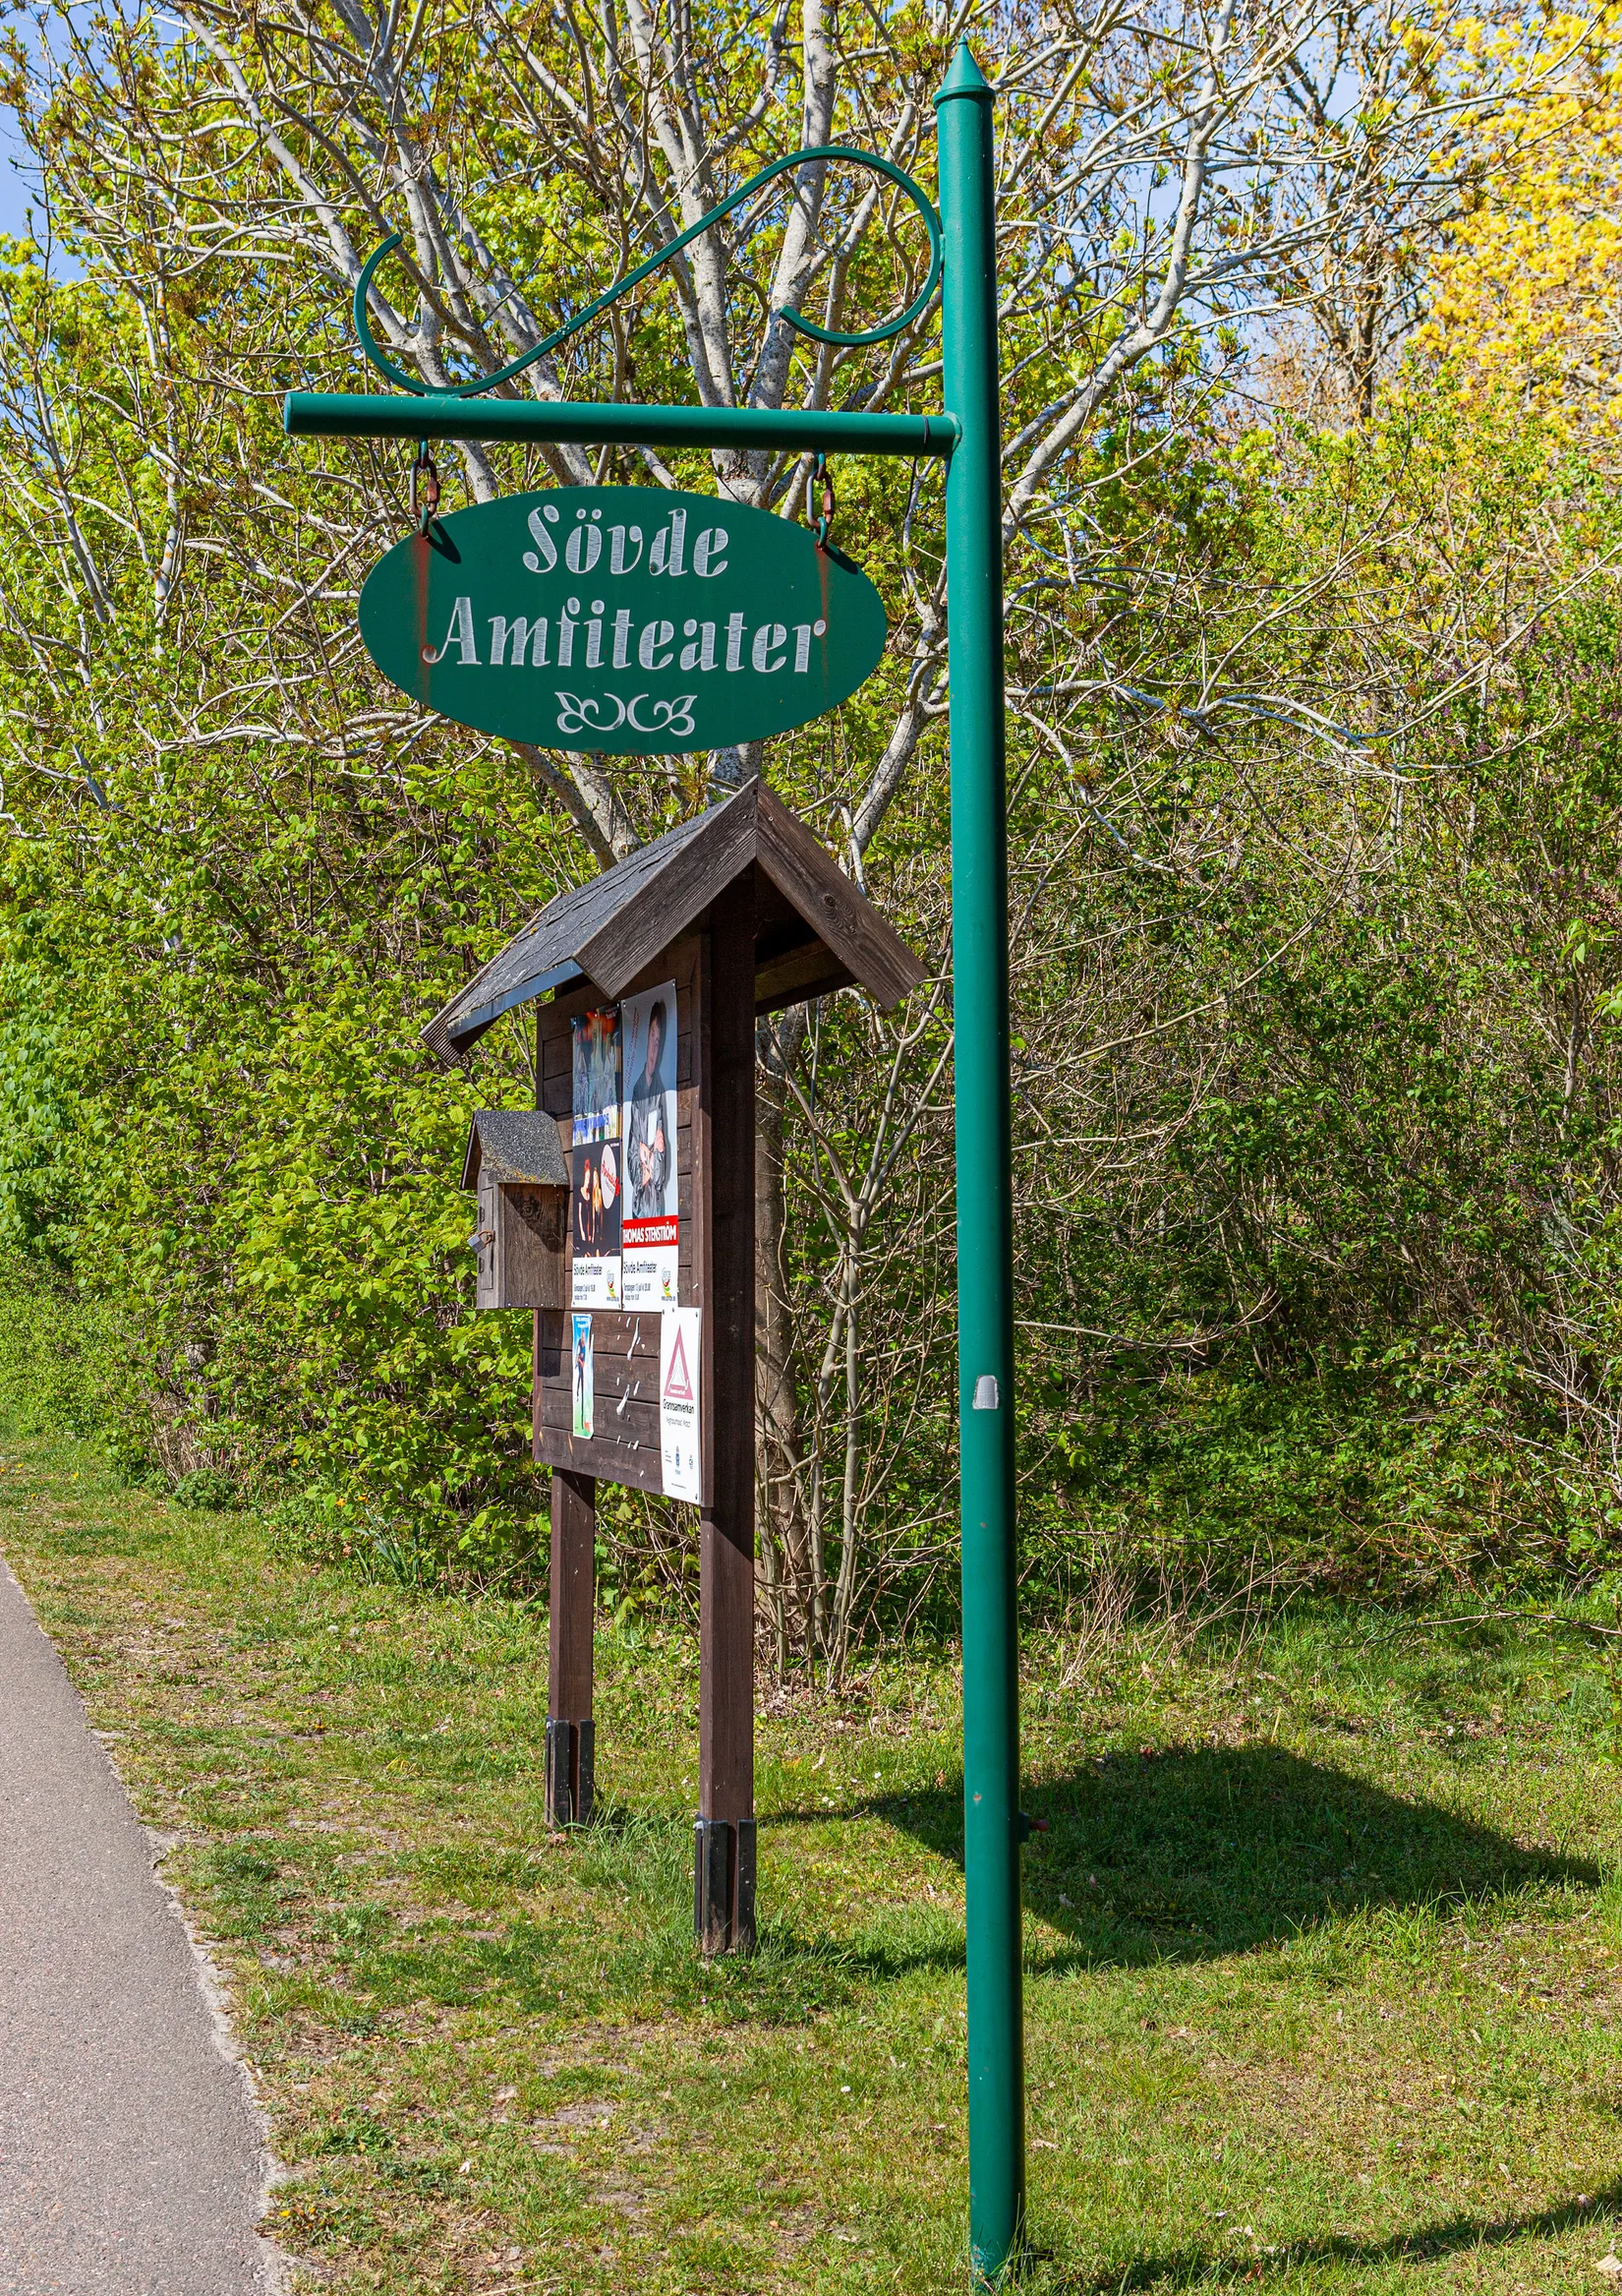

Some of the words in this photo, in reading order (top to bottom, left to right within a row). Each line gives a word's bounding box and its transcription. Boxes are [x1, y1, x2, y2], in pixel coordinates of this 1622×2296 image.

[522, 504, 729, 578] Sövde
[421, 596, 827, 674] Amfiteater
[622, 1227, 645, 1244] THOMAS
[645, 1221, 677, 1243] STENSTRÖM
